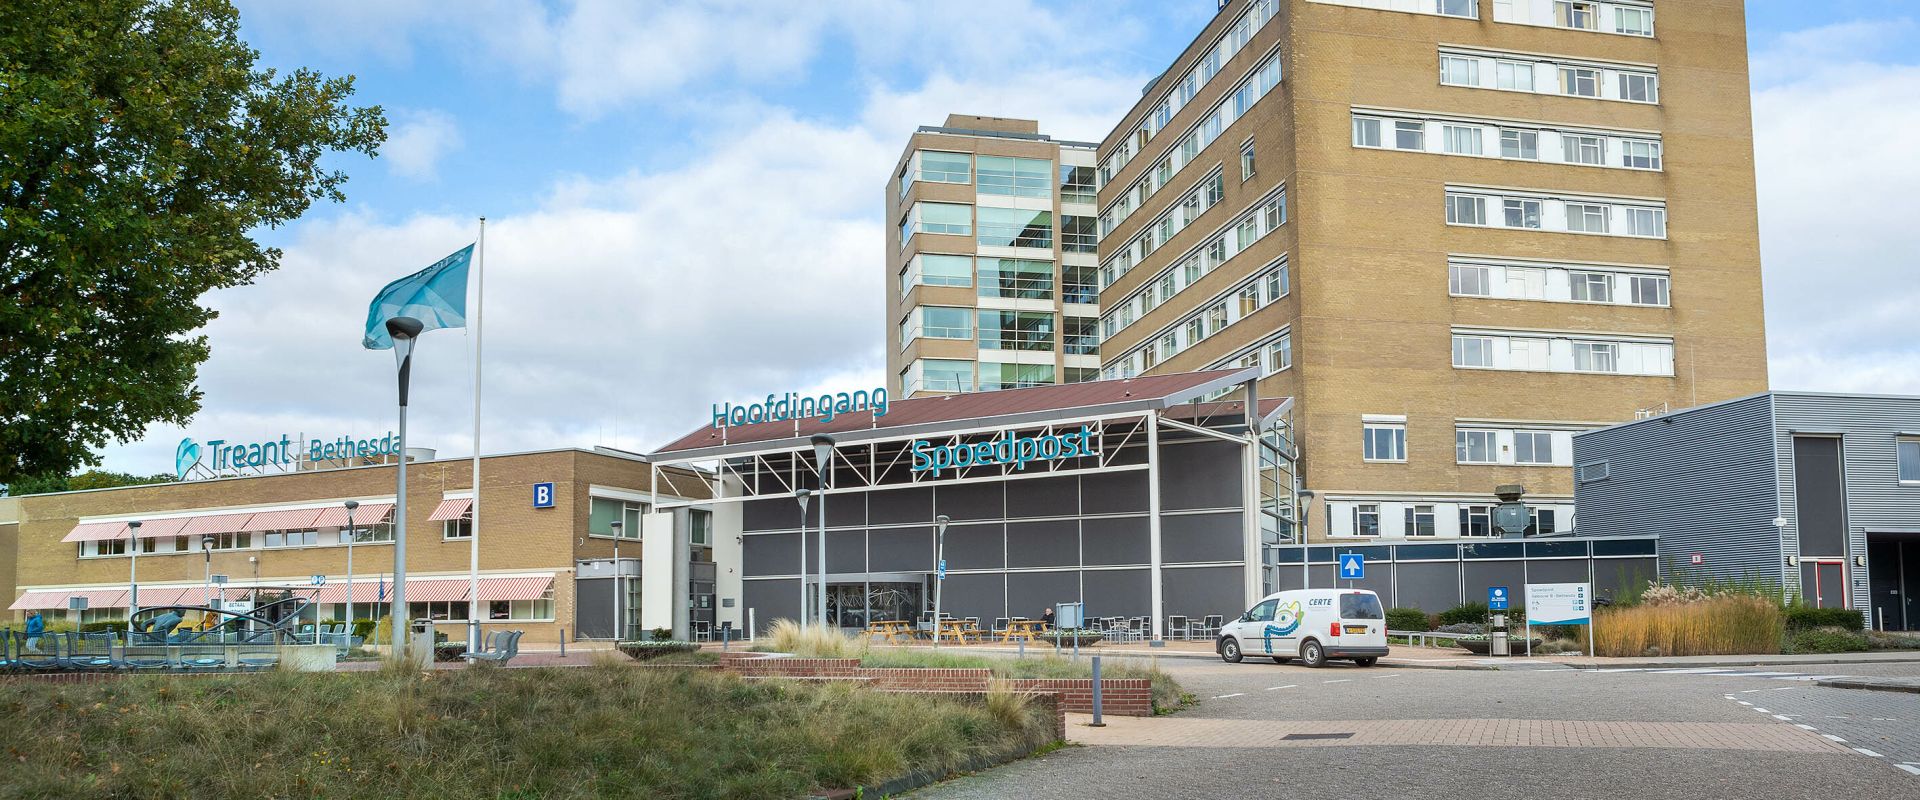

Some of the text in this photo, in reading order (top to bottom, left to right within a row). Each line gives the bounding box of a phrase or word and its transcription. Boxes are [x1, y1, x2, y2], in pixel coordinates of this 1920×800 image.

[713, 387, 889, 429] Hoofdingang
[207, 430, 401, 470] Treant Bethesda
[912, 424, 1095, 478] Spoedpost
[538, 486, 549, 504] B
[1309, 598, 1333, 606] CERTE
